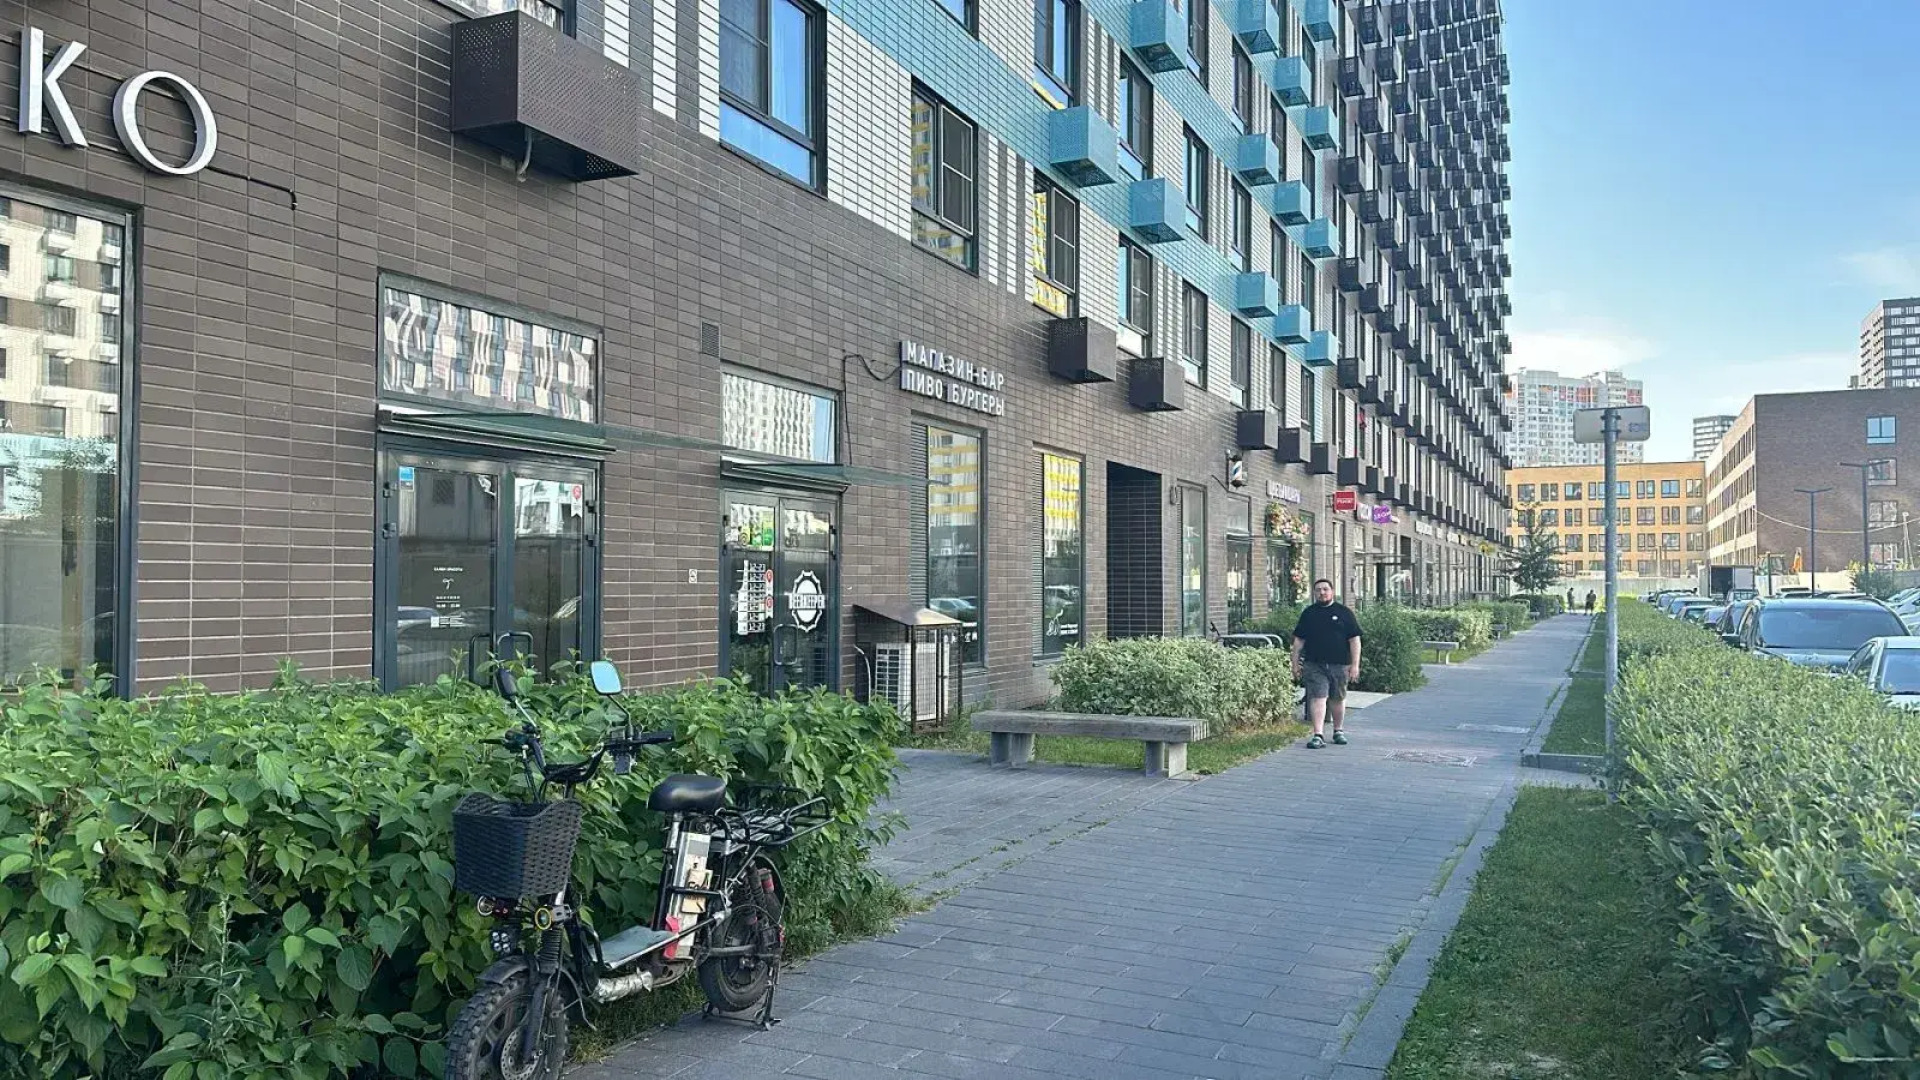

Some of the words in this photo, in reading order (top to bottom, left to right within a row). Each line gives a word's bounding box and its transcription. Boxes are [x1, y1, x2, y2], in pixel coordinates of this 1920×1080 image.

[19, 26, 218, 175] КО
[902, 340, 1004, 391] МАГАЗИН-БАР
[901, 369, 943, 399] ПИВО
[947, 383, 1005, 416] БУРГЕРЫ
